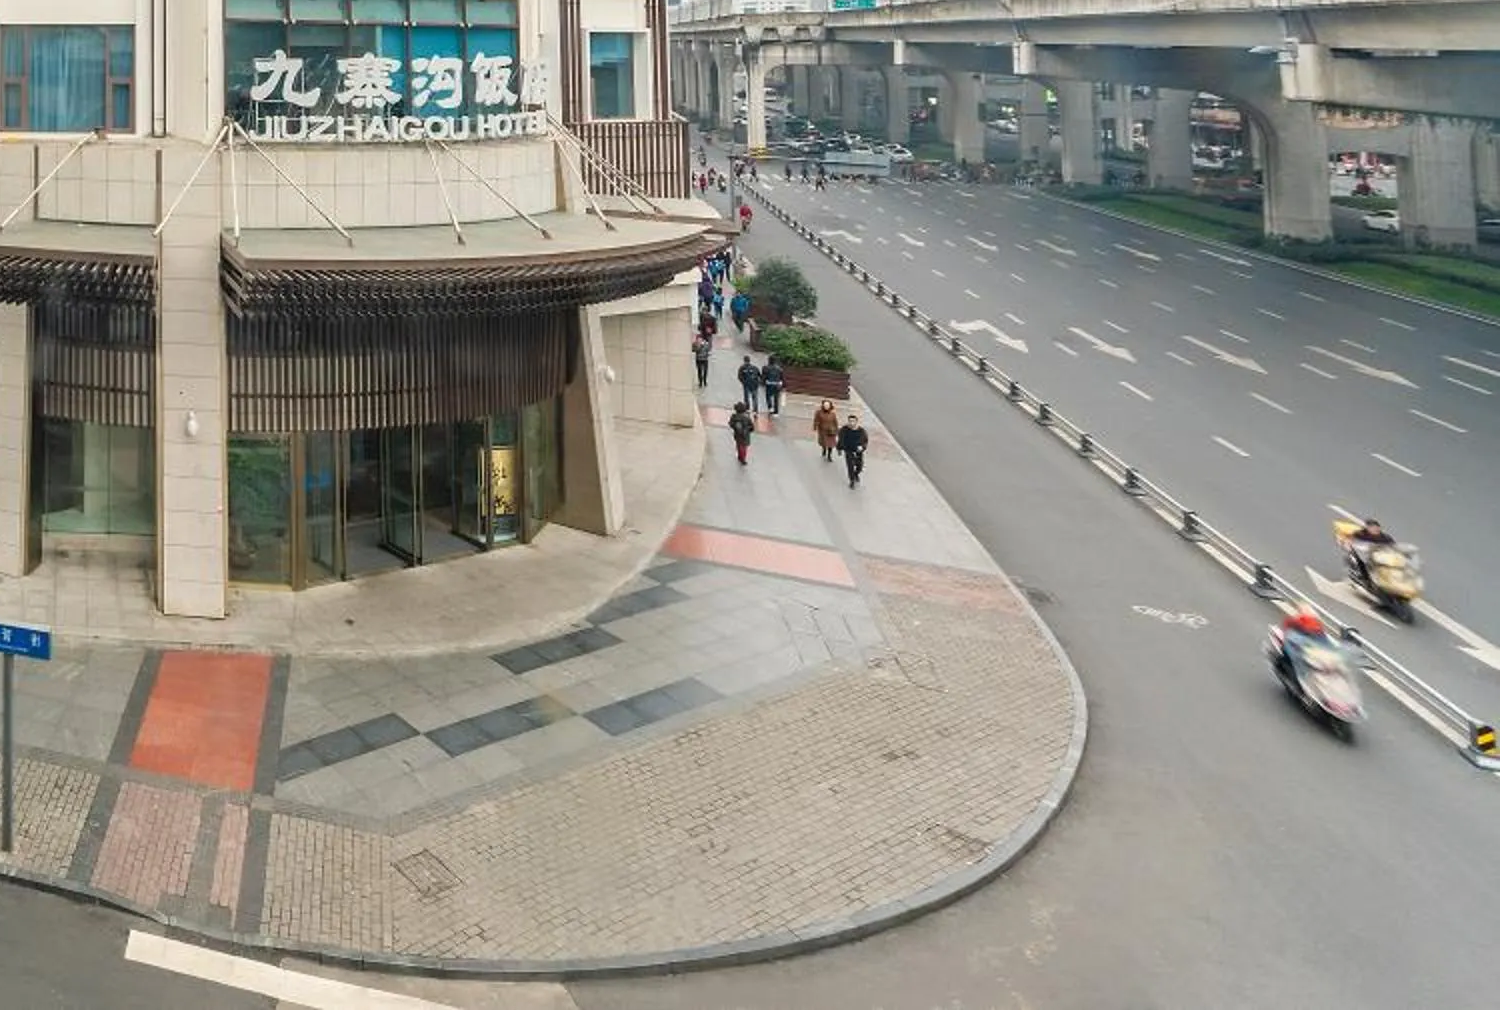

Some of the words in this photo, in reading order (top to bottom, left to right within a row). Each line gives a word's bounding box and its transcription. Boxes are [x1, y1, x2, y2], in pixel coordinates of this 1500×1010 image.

[251, 49, 548, 109] 九寨沟饭店
[250, 115, 470, 141] JIUZHAIGOU
